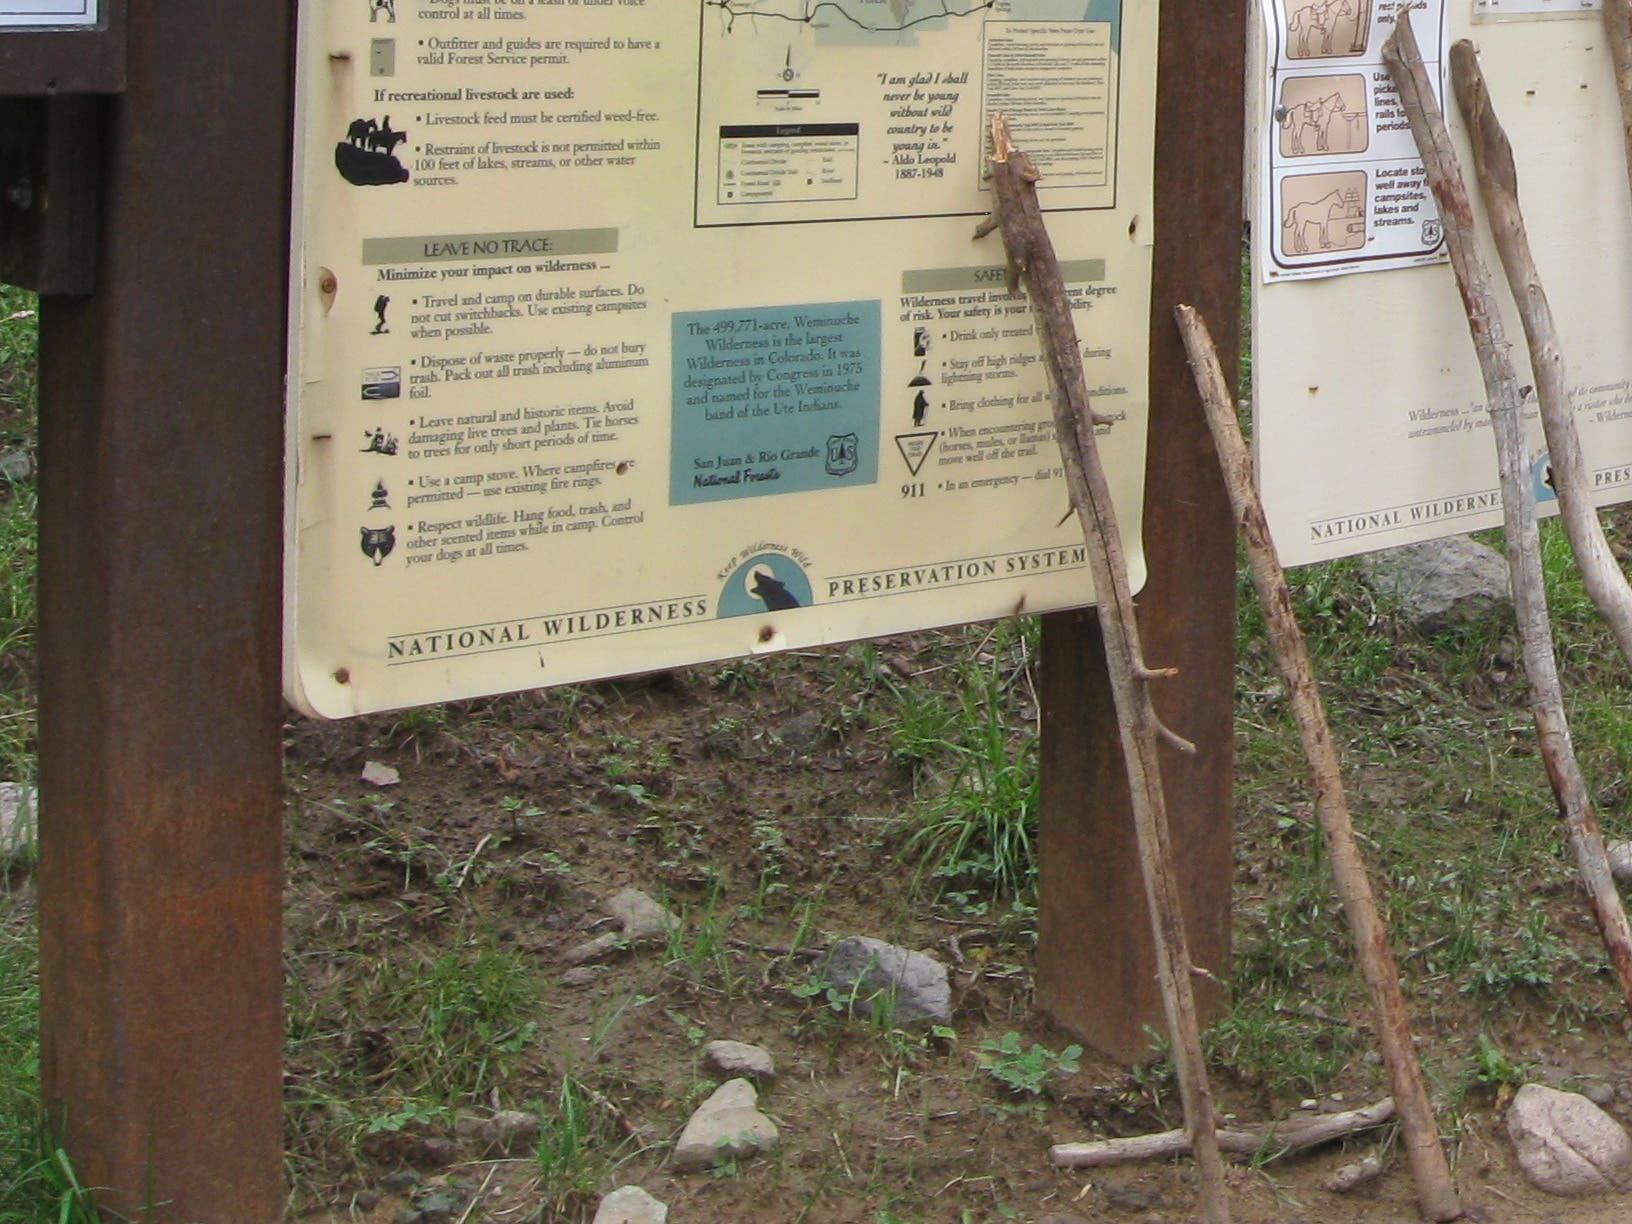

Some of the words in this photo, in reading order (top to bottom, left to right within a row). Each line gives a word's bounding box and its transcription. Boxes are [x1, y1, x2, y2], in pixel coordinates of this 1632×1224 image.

[888, 76, 906, 84] am
[908, 72, 933, 87] glad
[934, 73, 941, 84] I
[942, 72, 969, 84] shall
[1373, 73, 1391, 81] Use
[374, 89, 386, 102] If
[388, 88, 462, 101] recreational
[465, 88, 518, 100] livestock
[522, 91, 540, 100] are
[544, 87, 574, 99] used:
[882, 92, 912, 101] never
[913, 89, 925, 100] be
[927, 92, 960, 104] young
[1373, 83, 1399, 95] picke
[425, 113, 480, 126] Livestock
[484, 111, 507, 124] feed
[510, 114, 537, 124] must
[540, 111, 554, 123] be
[557, 110, 601, 123] certified
[604, 109, 659, 122] weed-free.
[889, 106, 928, 117] without
[931, 104, 953, 116] wild
[1375, 109, 1395, 119] rails
[886, 124, 927, 137] country
[929, 124, 940, 133] to
[942, 121, 954, 133] be
[892, 143, 925, 154] young
[892, 155, 915, 165] Aldo
[917, 152, 957, 166] Leopold
[895, 168, 945, 179] 1887-1948
[1375, 167, 1409, 178] Locate
[1375, 179, 1395, 190] well
[1396, 178, 1422, 189] away
[1374, 204, 1400, 215] lakes
[1401, 203, 1419, 212] and
[1374, 215, 1415, 227] streams.
[423, 240, 470, 257] LEAVE
[473, 239, 499, 255] NO
[502, 238, 553, 253] TRACE:
[377, 267, 438, 282] Minimize
[440, 267, 468, 282] your
[472, 263, 513, 280] impact
[516, 264, 532, 273] on
[535, 259, 597, 273] wilderness
[687, 322, 710, 336] The
[793, 312, 860, 327] Weminuche
[705, 338, 770, 352] Wilderness
[773, 335, 782, 347] is
[784, 333, 802, 346] the
[805, 332, 843, 349] largest
[686, 357, 749, 371] Wilderness
[753, 355, 765, 366] in
[827, 347, 837, 360] It
[839, 350, 862, 359] was
[683, 371, 746, 390] designated
[750, 369, 763, 385] by
[766, 368, 819, 384] Congress
[822, 365, 833, 377] in
[836, 362, 863, 377] 1975
[686, 391, 709, 406] and
[711, 388, 750, 403] named
[752, 385, 770, 400] for
[773, 384, 791, 398] the
[794, 378, 860, 395] Weminuche
[705, 406, 734, 421] band
[737, 404, 750, 418] of
[752, 404, 770, 417] the
[693, 456, 714, 470] San
[715, 455, 742, 470] Juan
[745, 453, 755, 465] &
[758, 451, 778, 464] Rio
[780, 446, 820, 462] Grande
[693, 470, 741, 489] National
[743, 467, 781, 484] Forests
[901, 483, 926, 499] 911
[1310, 511, 1402, 540] NATIONAL
[1410, 492, 1502, 521] WILDERNE
[740, 543, 788, 558] Wilderness
[790, 547, 813, 569] Wild
[387, 623, 531, 659] NATIONAL
[543, 599, 709, 637] WILDERNESS
[827, 559, 998, 598] PRESERVATION
[1006, 547, 1087, 573] SYSTEM
